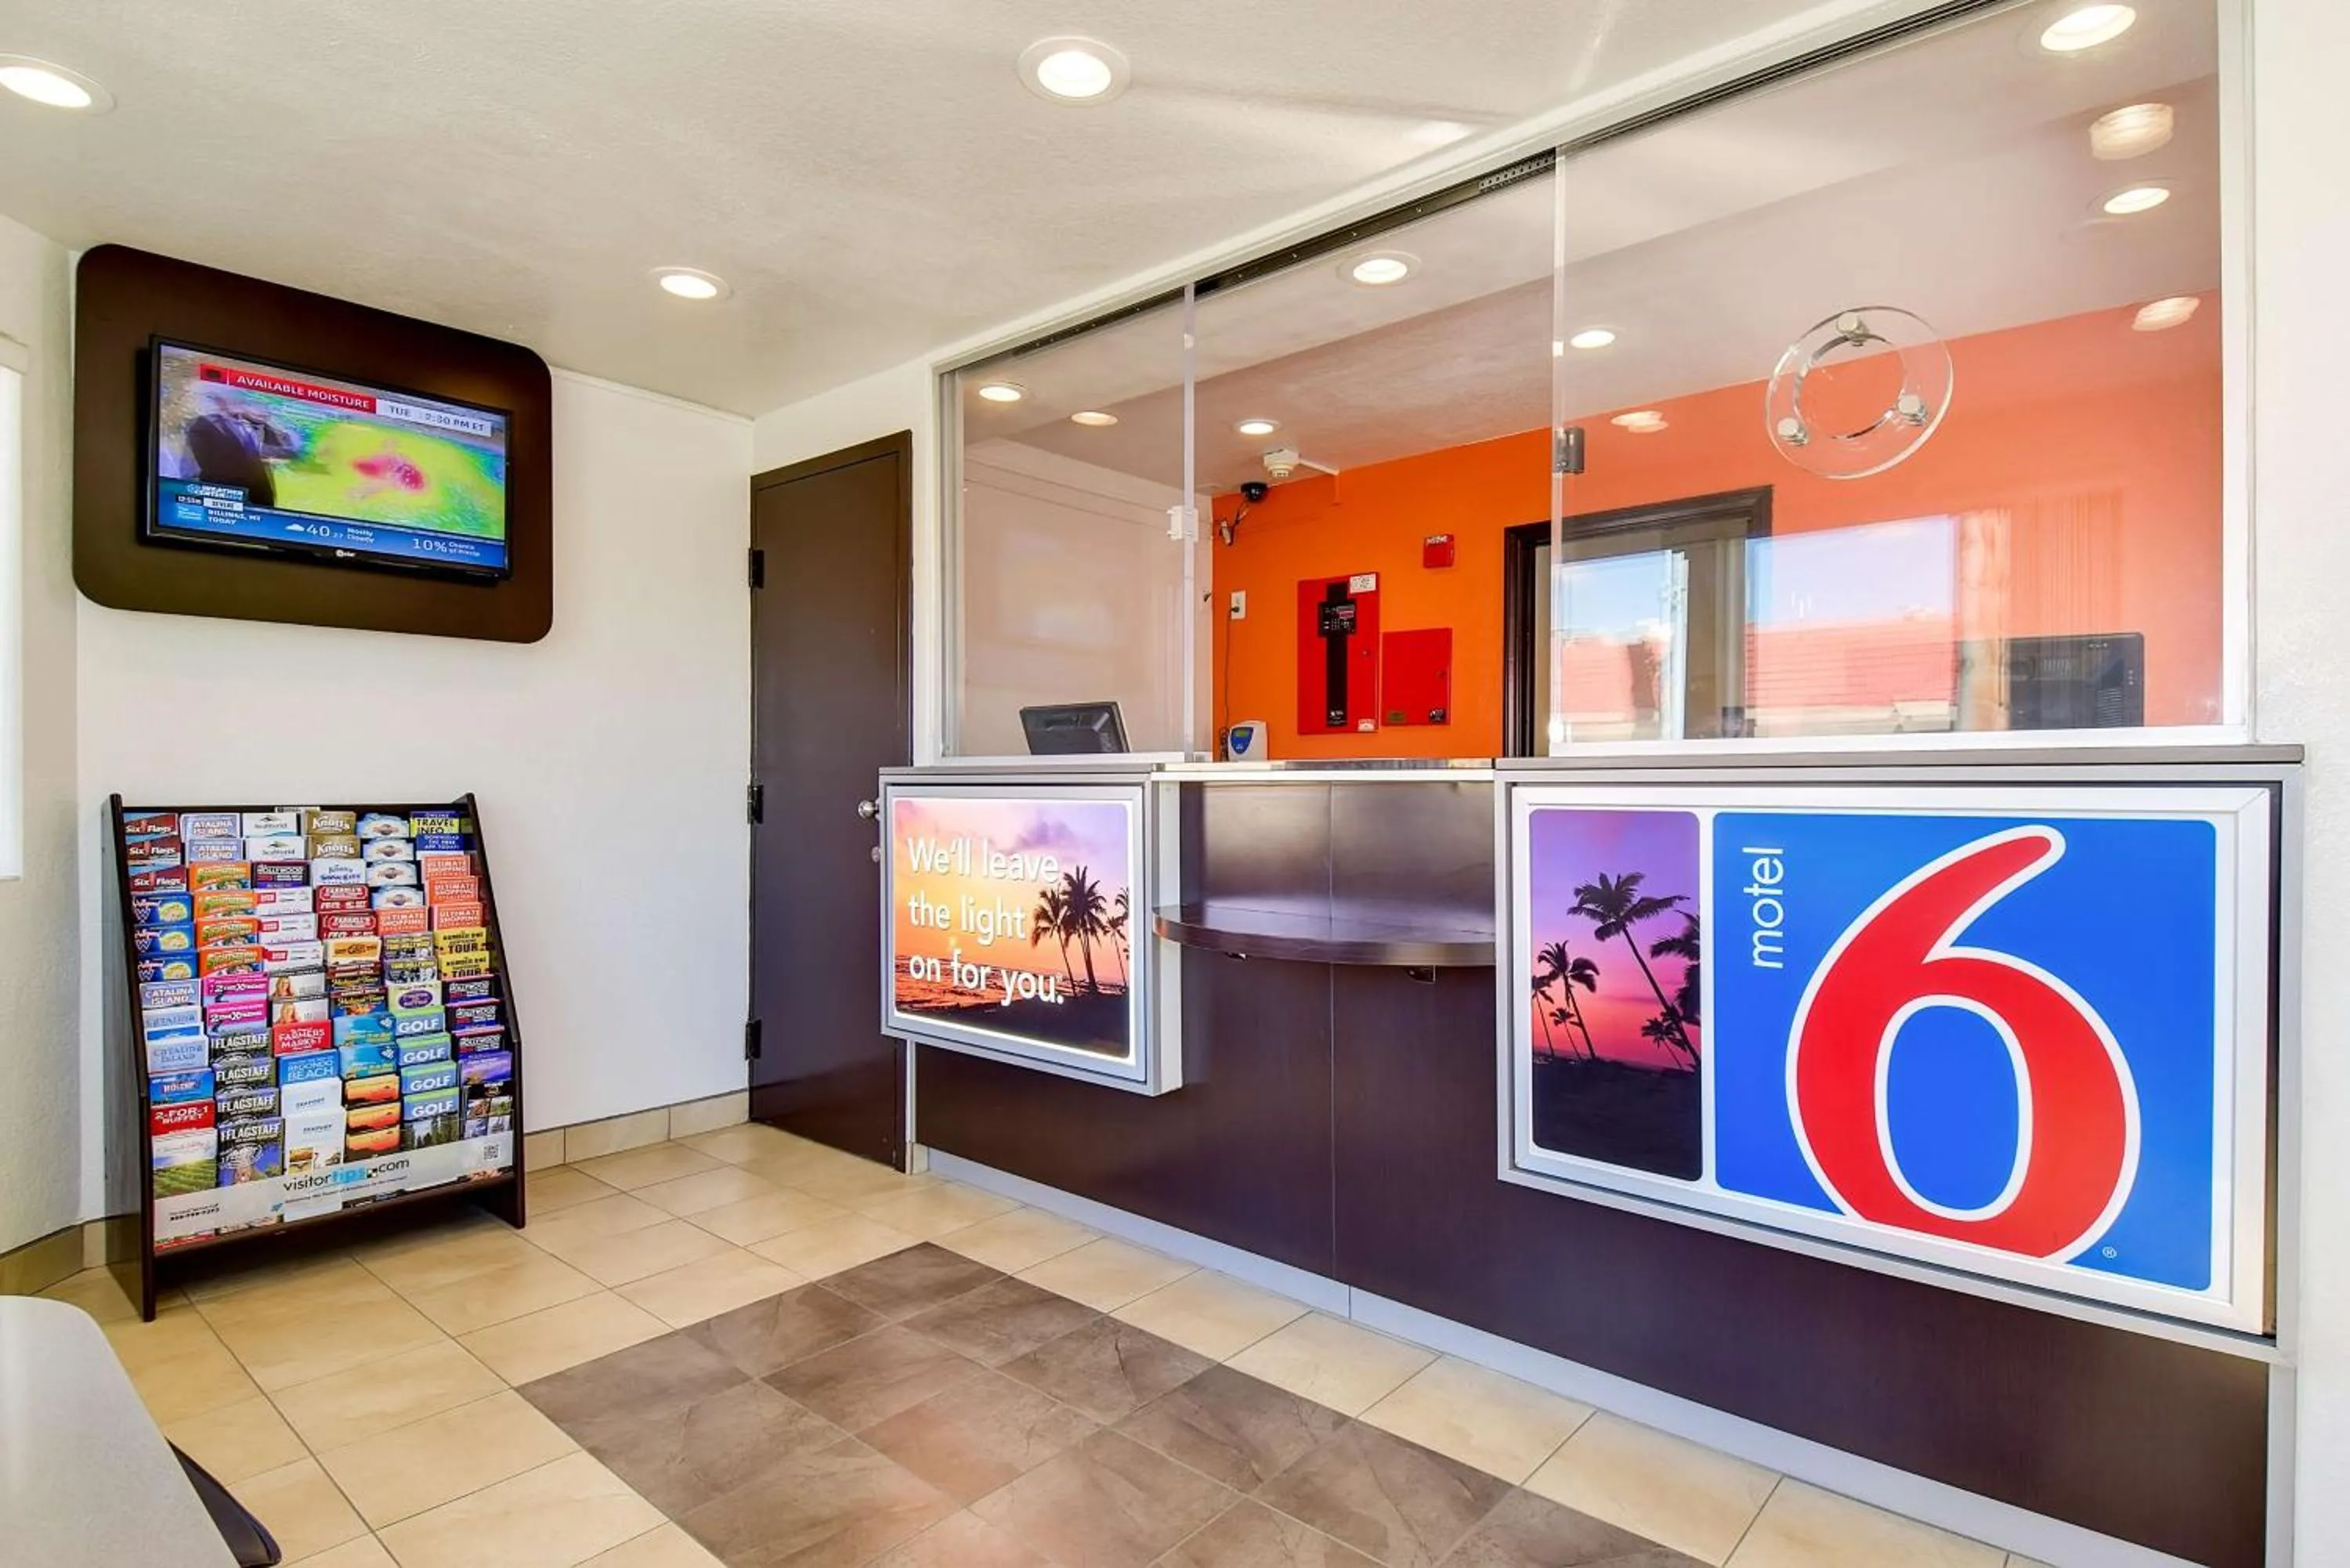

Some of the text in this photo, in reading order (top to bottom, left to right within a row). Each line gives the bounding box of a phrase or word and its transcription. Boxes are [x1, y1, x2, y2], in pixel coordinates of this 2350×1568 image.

[237, 375, 371, 409] AVAILABLE MOISTURE
[389, 406, 410, 416] TUE
[454, 420, 469, 428] PM
[306, 524, 330, 537] 40
[413, 538, 447, 552] 10%
[125, 825, 172, 833] Six Flags
[128, 847, 176, 855] Six Flags
[907, 836, 1060, 883] We'll leave
[156, 877, 181, 886] Flags
[909, 892, 1027, 946] the light
[448, 942, 479, 954] TOUR
[909, 955, 941, 982] on
[950, 948, 991, 989] for
[145, 987, 194, 997] CATALINA
[151, 995, 190, 1006] ISLAND
[399, 1019, 439, 1033] GOLF
[215, 1033, 268, 1049] FLAGSTAFF
[281, 1037, 323, 1049] MARKET
[1741, 824, 2141, 1263] motel 6
[403, 1047, 446, 1064] GOLF
[216, 1064, 271, 1082] FLAGSTAFF
[287, 1067, 334, 1081] BEACH
[410, 1075, 452, 1091] GOLF
[222, 1096, 274, 1112] FLAGSTAFF
[411, 1100, 454, 1117] GOLF
[155, 1107, 208, 1119] 2-FOR-1
[162, 1113, 204, 1125] BUFFET
[226, 1122, 281, 1140] FLAGSTAFF
